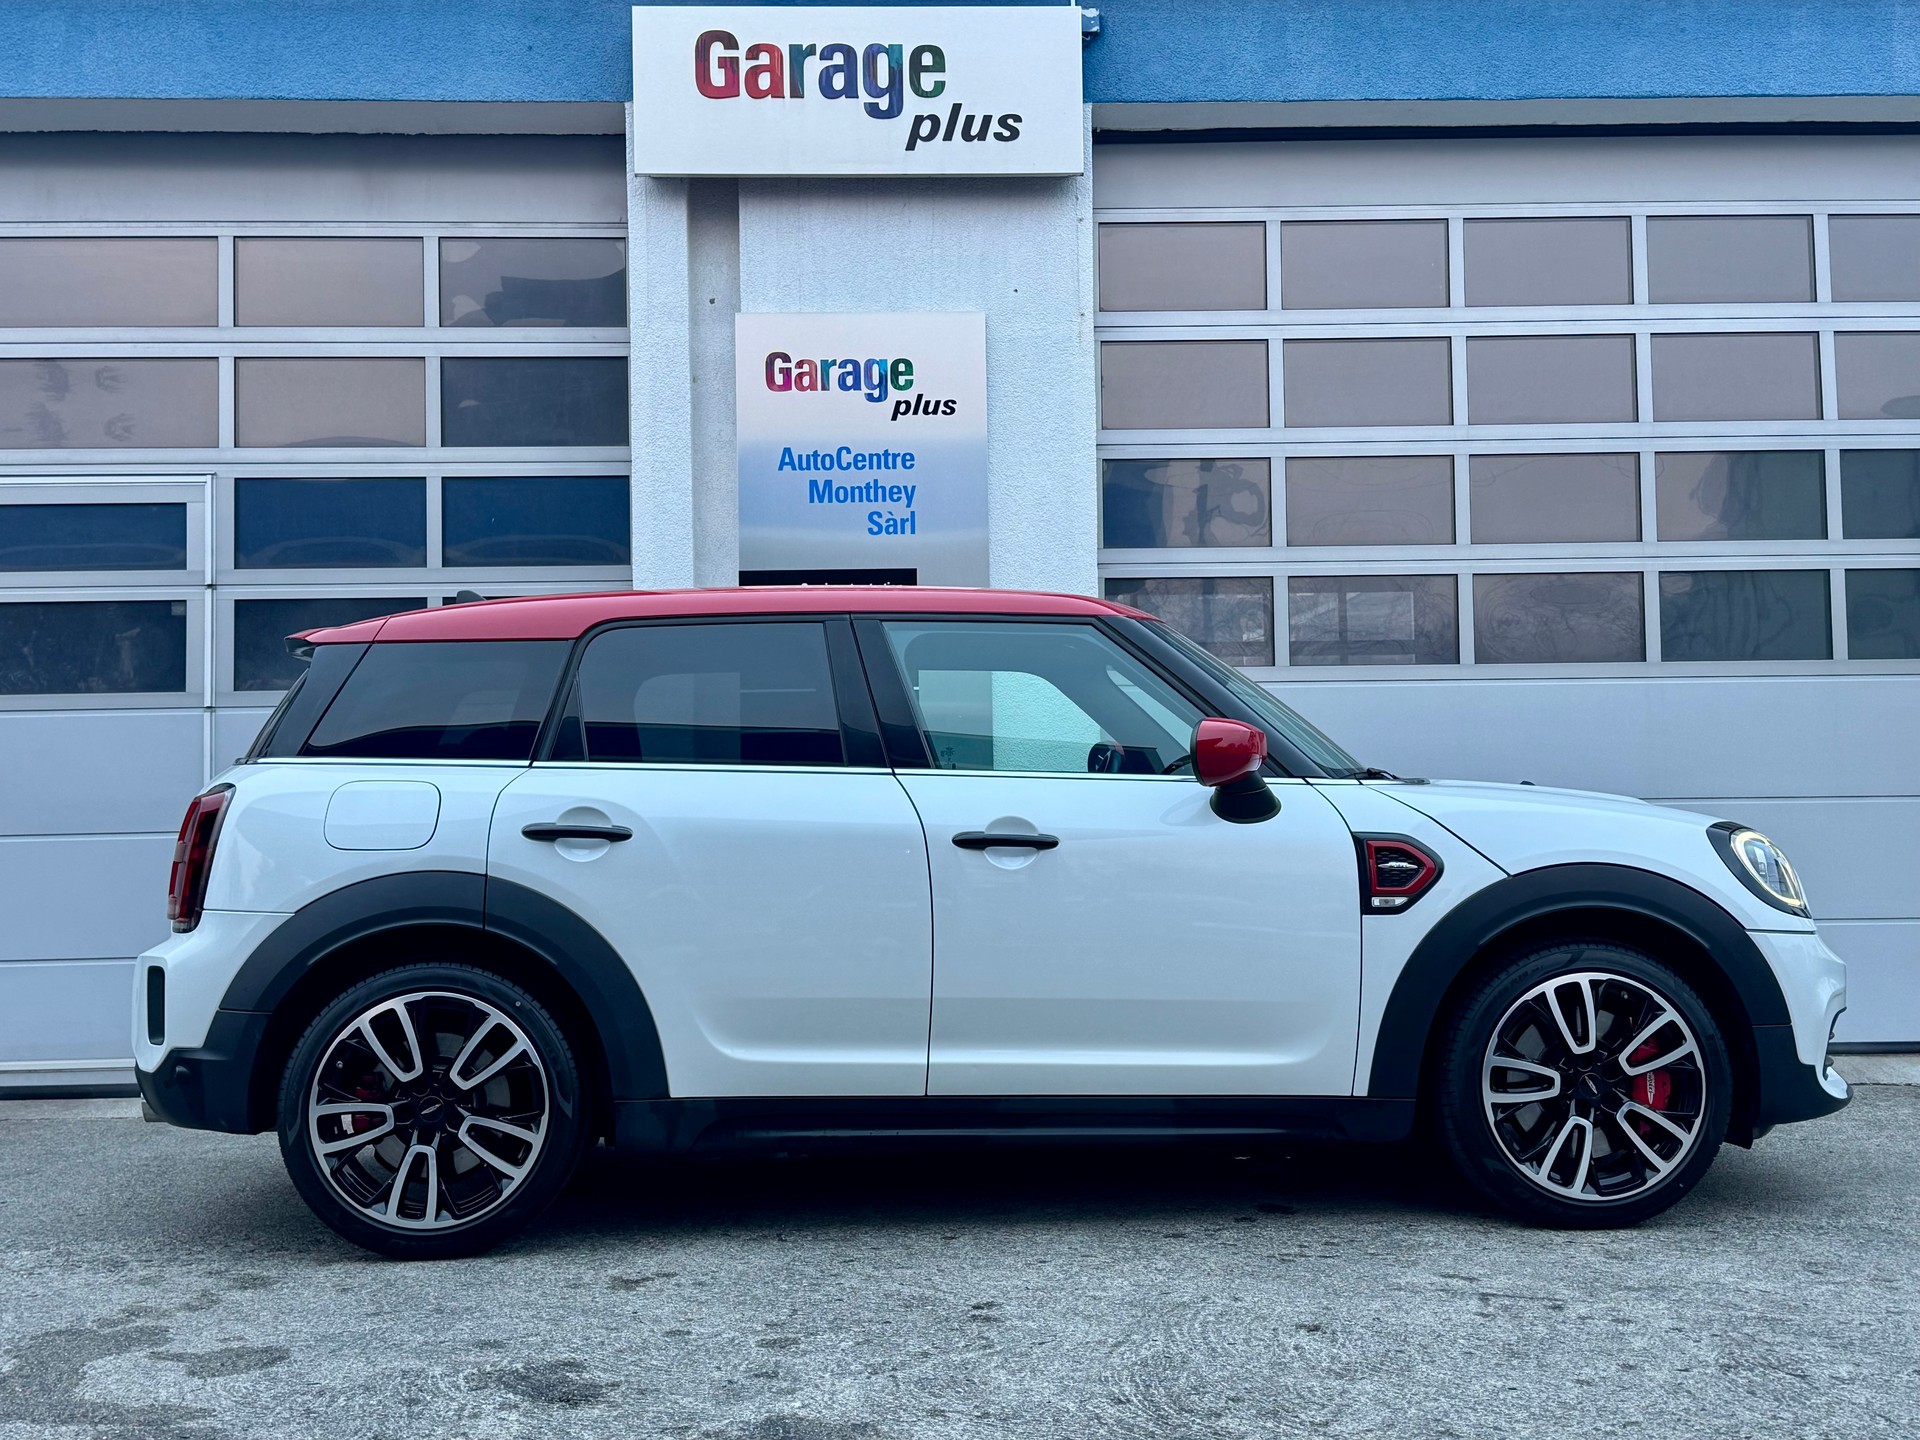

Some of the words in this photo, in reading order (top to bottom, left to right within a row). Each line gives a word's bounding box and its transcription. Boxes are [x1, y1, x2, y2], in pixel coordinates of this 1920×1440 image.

[694, 29, 946, 119] Garage
[904, 102, 1023, 151] plus
[765, 351, 914, 403] Garage
[890, 393, 957, 422] plus
[777, 446, 916, 472] AutoCentre
[808, 478, 917, 508] Monthey
[867, 510, 916, 536] Sàrl
